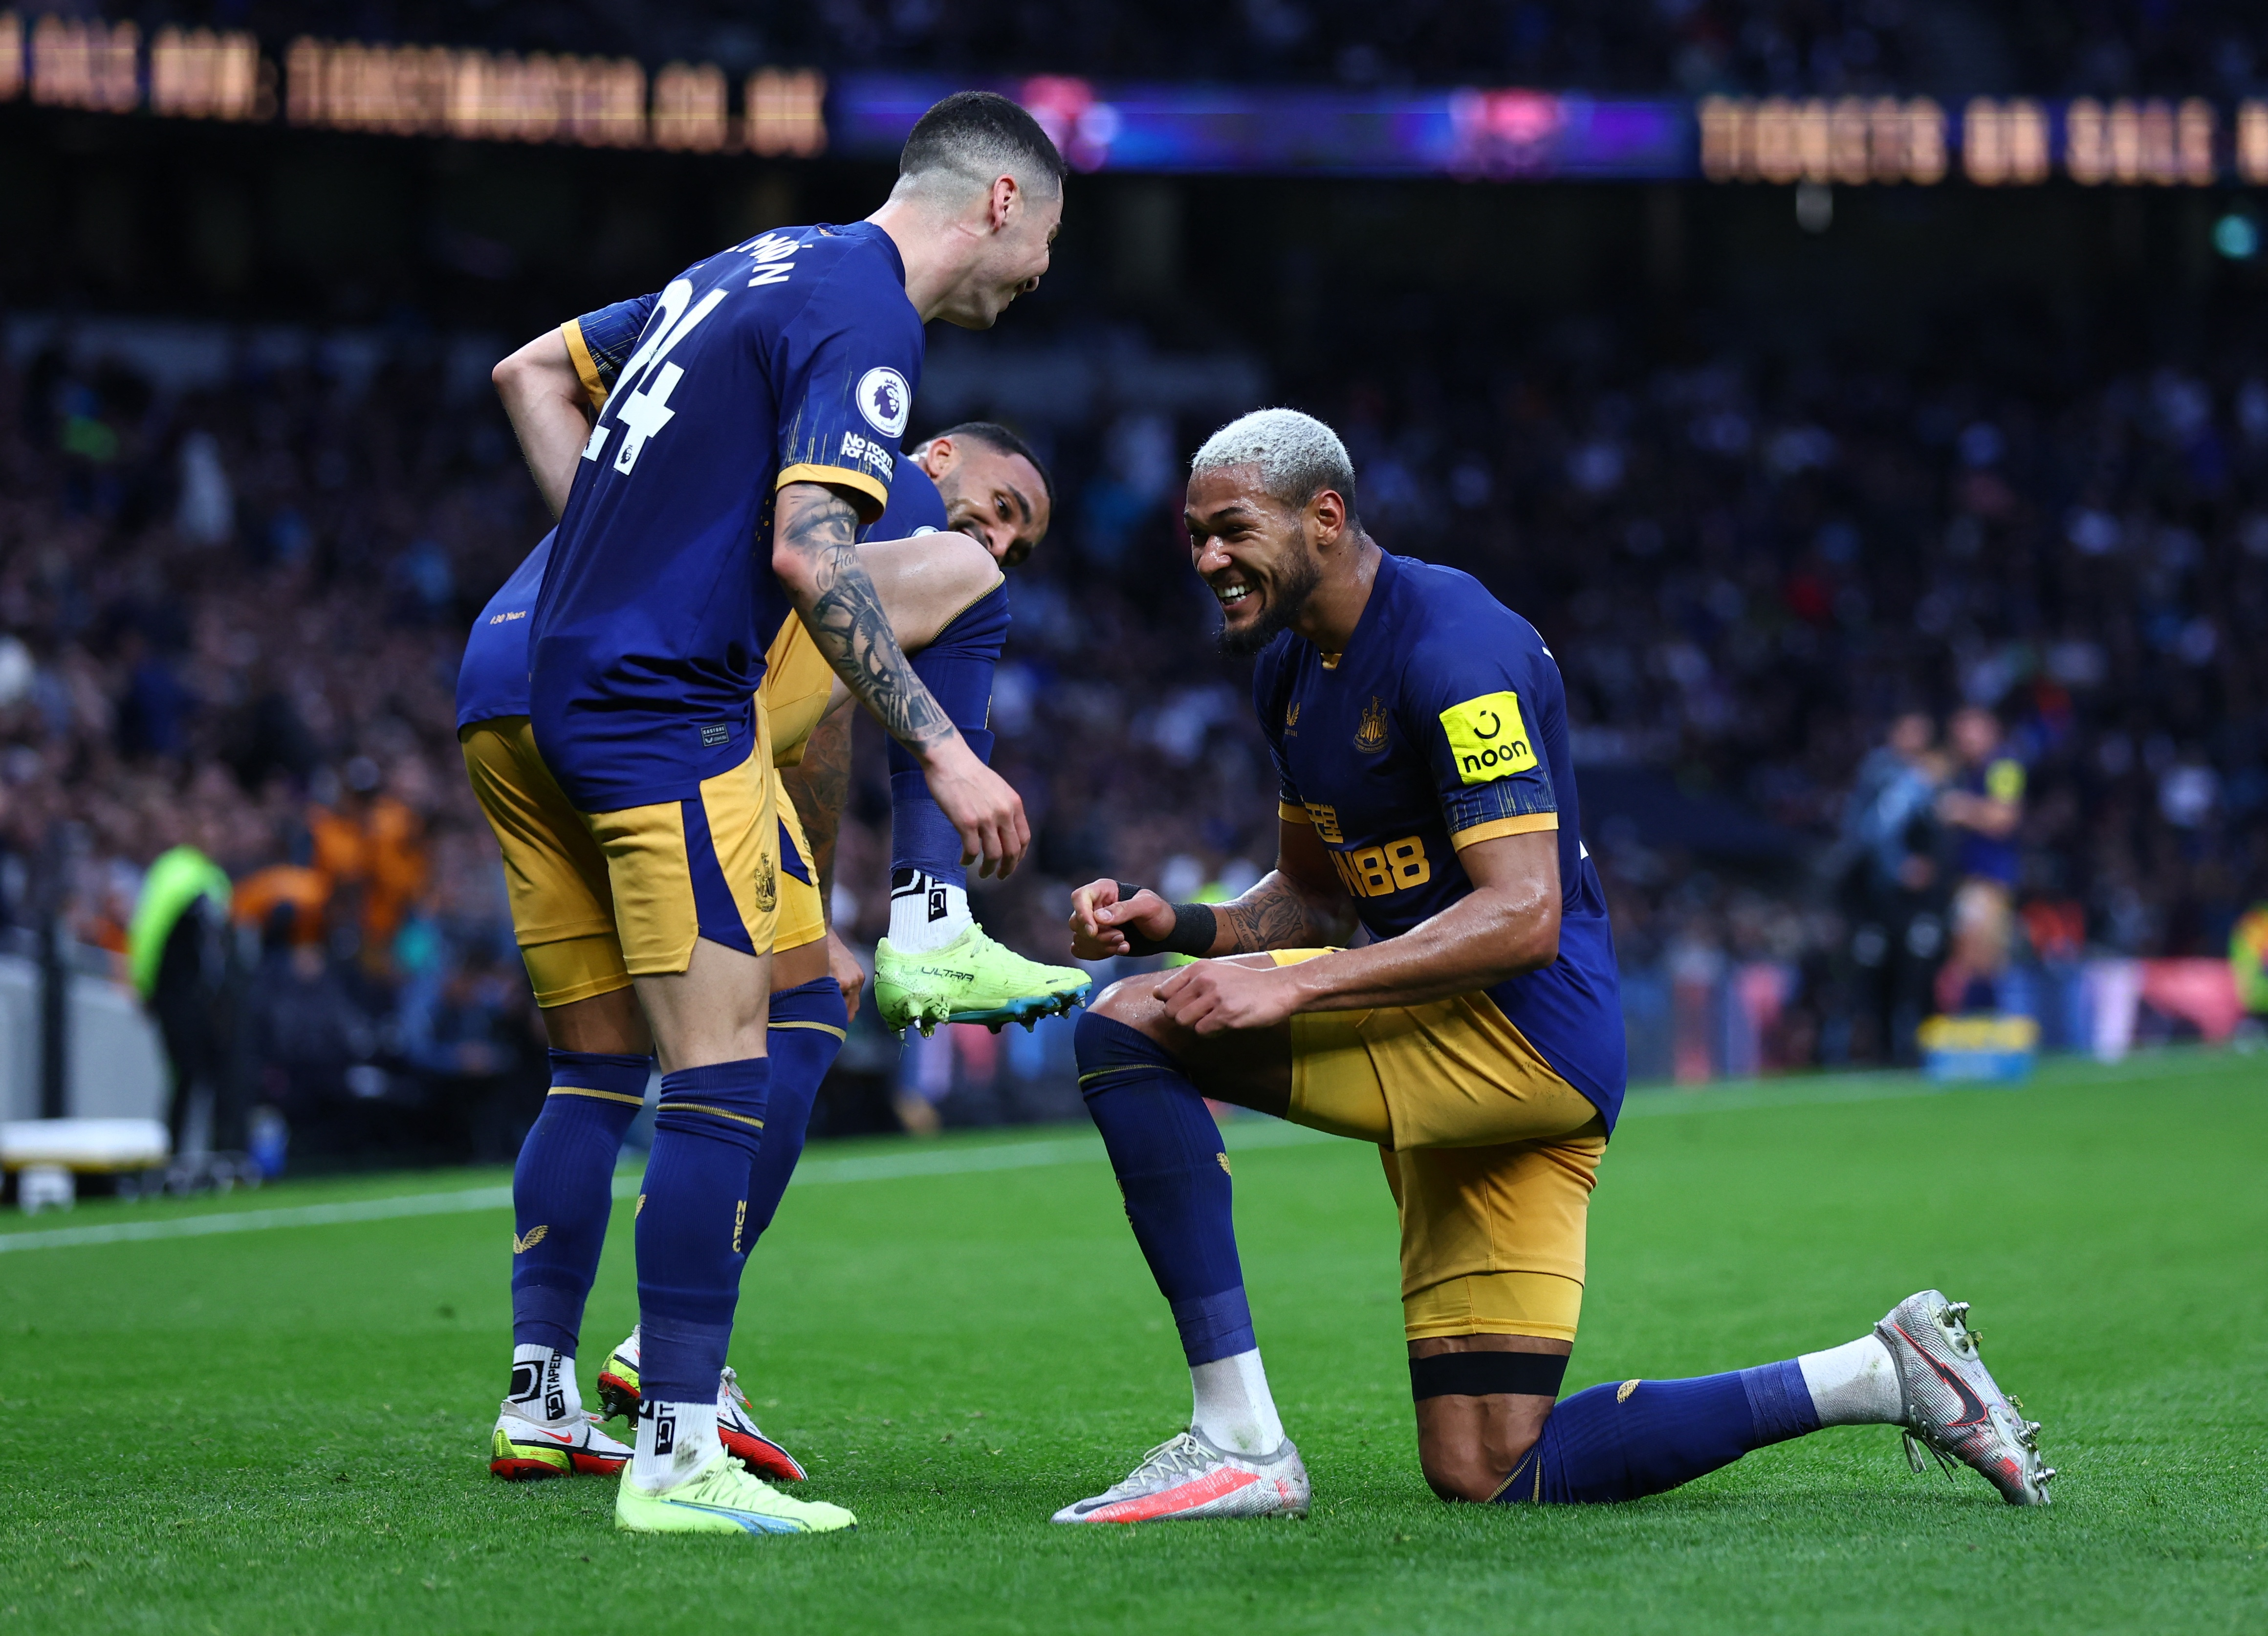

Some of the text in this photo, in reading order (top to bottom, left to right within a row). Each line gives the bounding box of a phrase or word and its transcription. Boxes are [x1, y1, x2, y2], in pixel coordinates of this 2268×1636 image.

[581, 278, 730, 476] 24
[841, 442, 893, 483] for racism
[843, 431, 893, 469] No room
[703, 726, 725, 734] CASTORE
[1462, 740, 1527, 773] noon
[921, 966, 975, 984] ULTRA
[732, 1199, 747, 1253] NUFC
